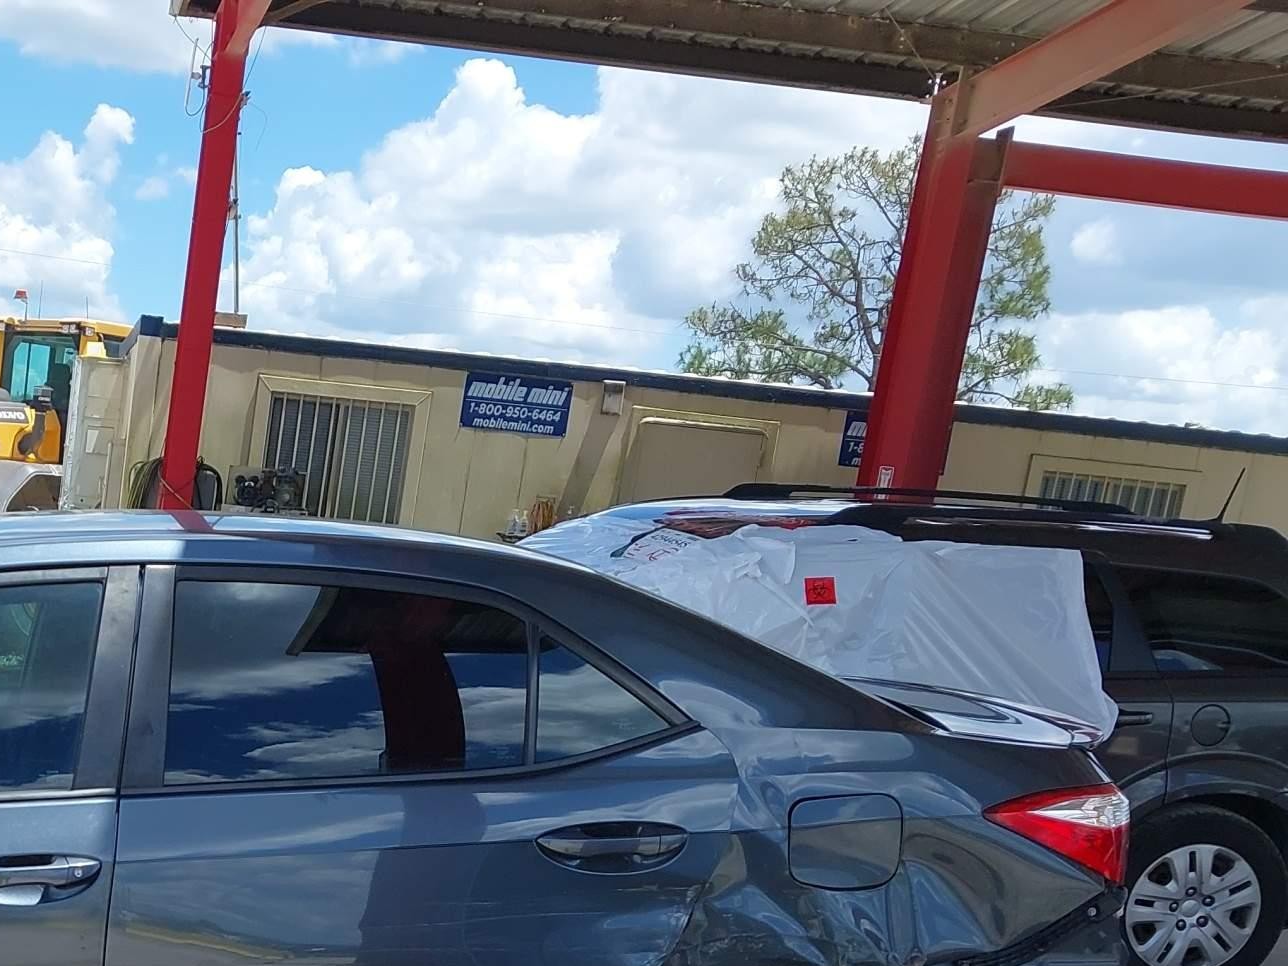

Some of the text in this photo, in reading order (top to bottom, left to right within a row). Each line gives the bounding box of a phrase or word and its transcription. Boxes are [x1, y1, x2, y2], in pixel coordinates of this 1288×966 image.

[467, 377, 570, 406] mobile mini
[469, 402, 561, 422] 1-800-950-6464
[472, 416, 554, 435] mobilemini.com
